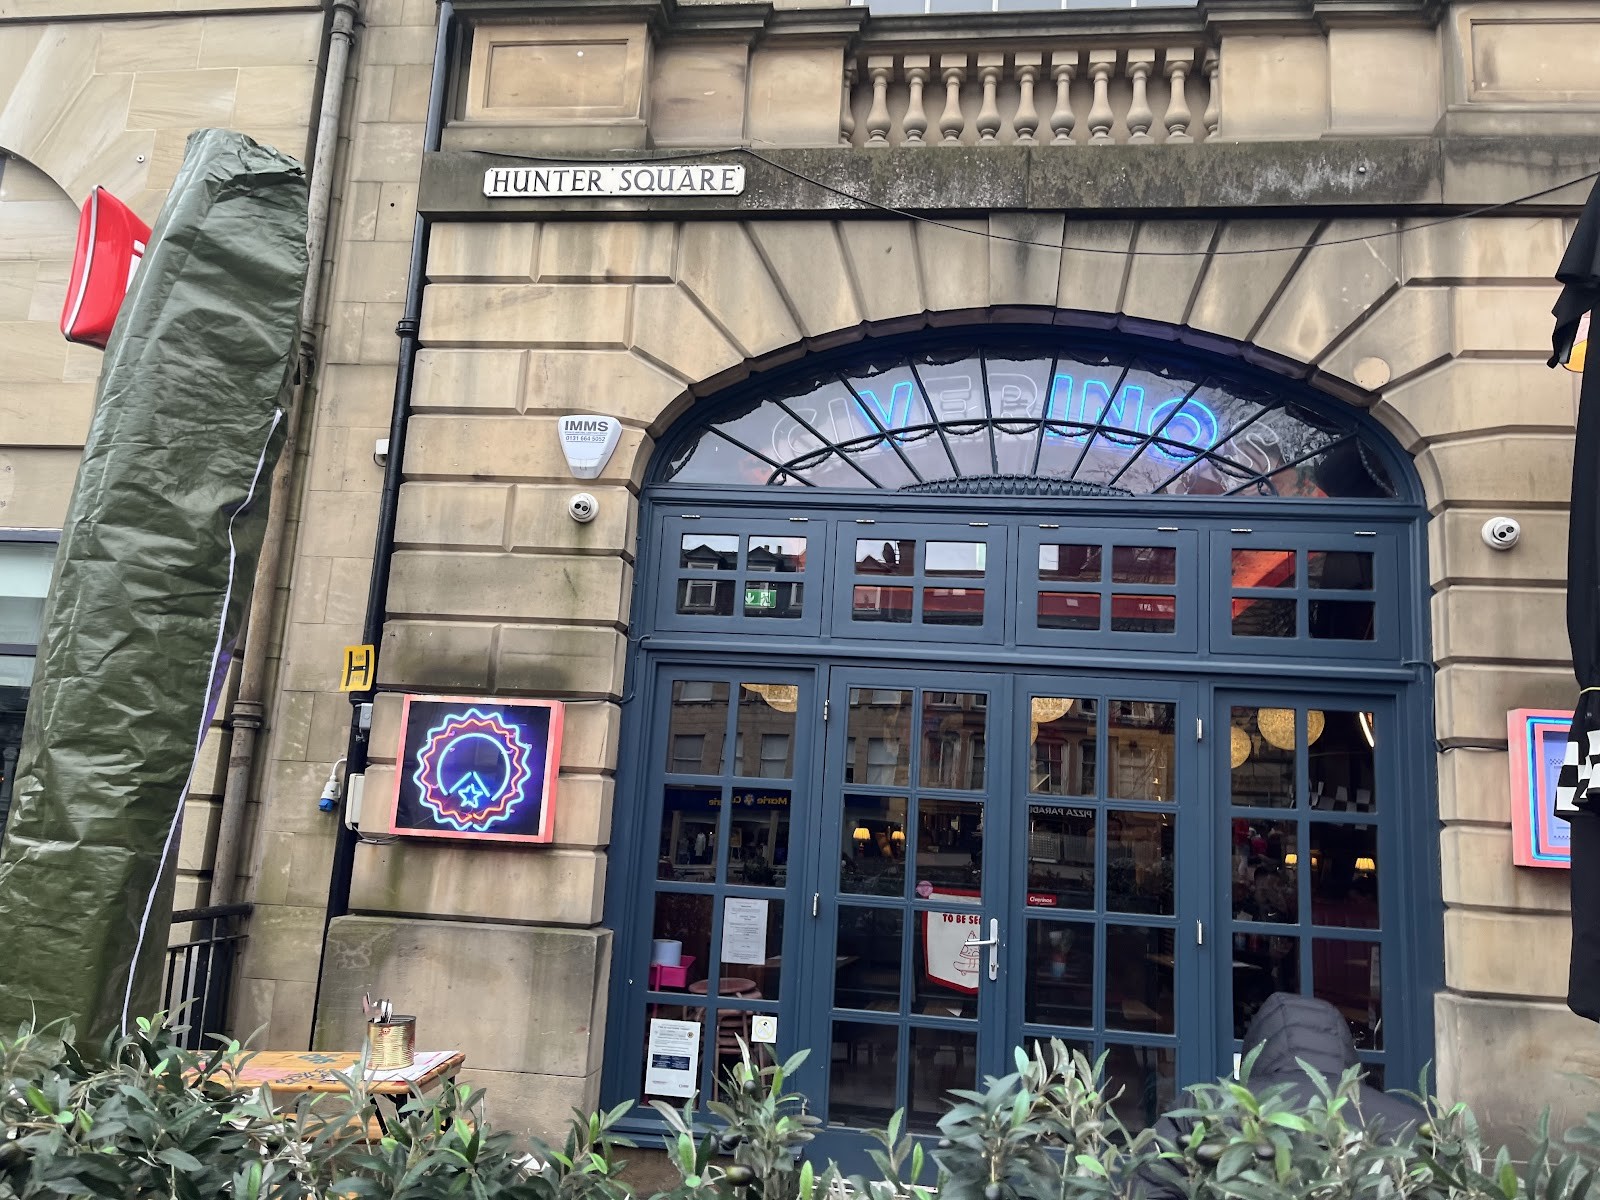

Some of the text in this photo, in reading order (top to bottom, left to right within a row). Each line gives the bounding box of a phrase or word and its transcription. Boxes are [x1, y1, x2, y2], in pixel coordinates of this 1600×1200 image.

[492, 168, 737, 193] HUNTER SQUARE
[565, 420, 609, 432] IMMS
[771, 373, 1279, 478] CIVERINOS
[345, 649, 370, 686] H
[942, 913, 981, 925] TO BE SE
